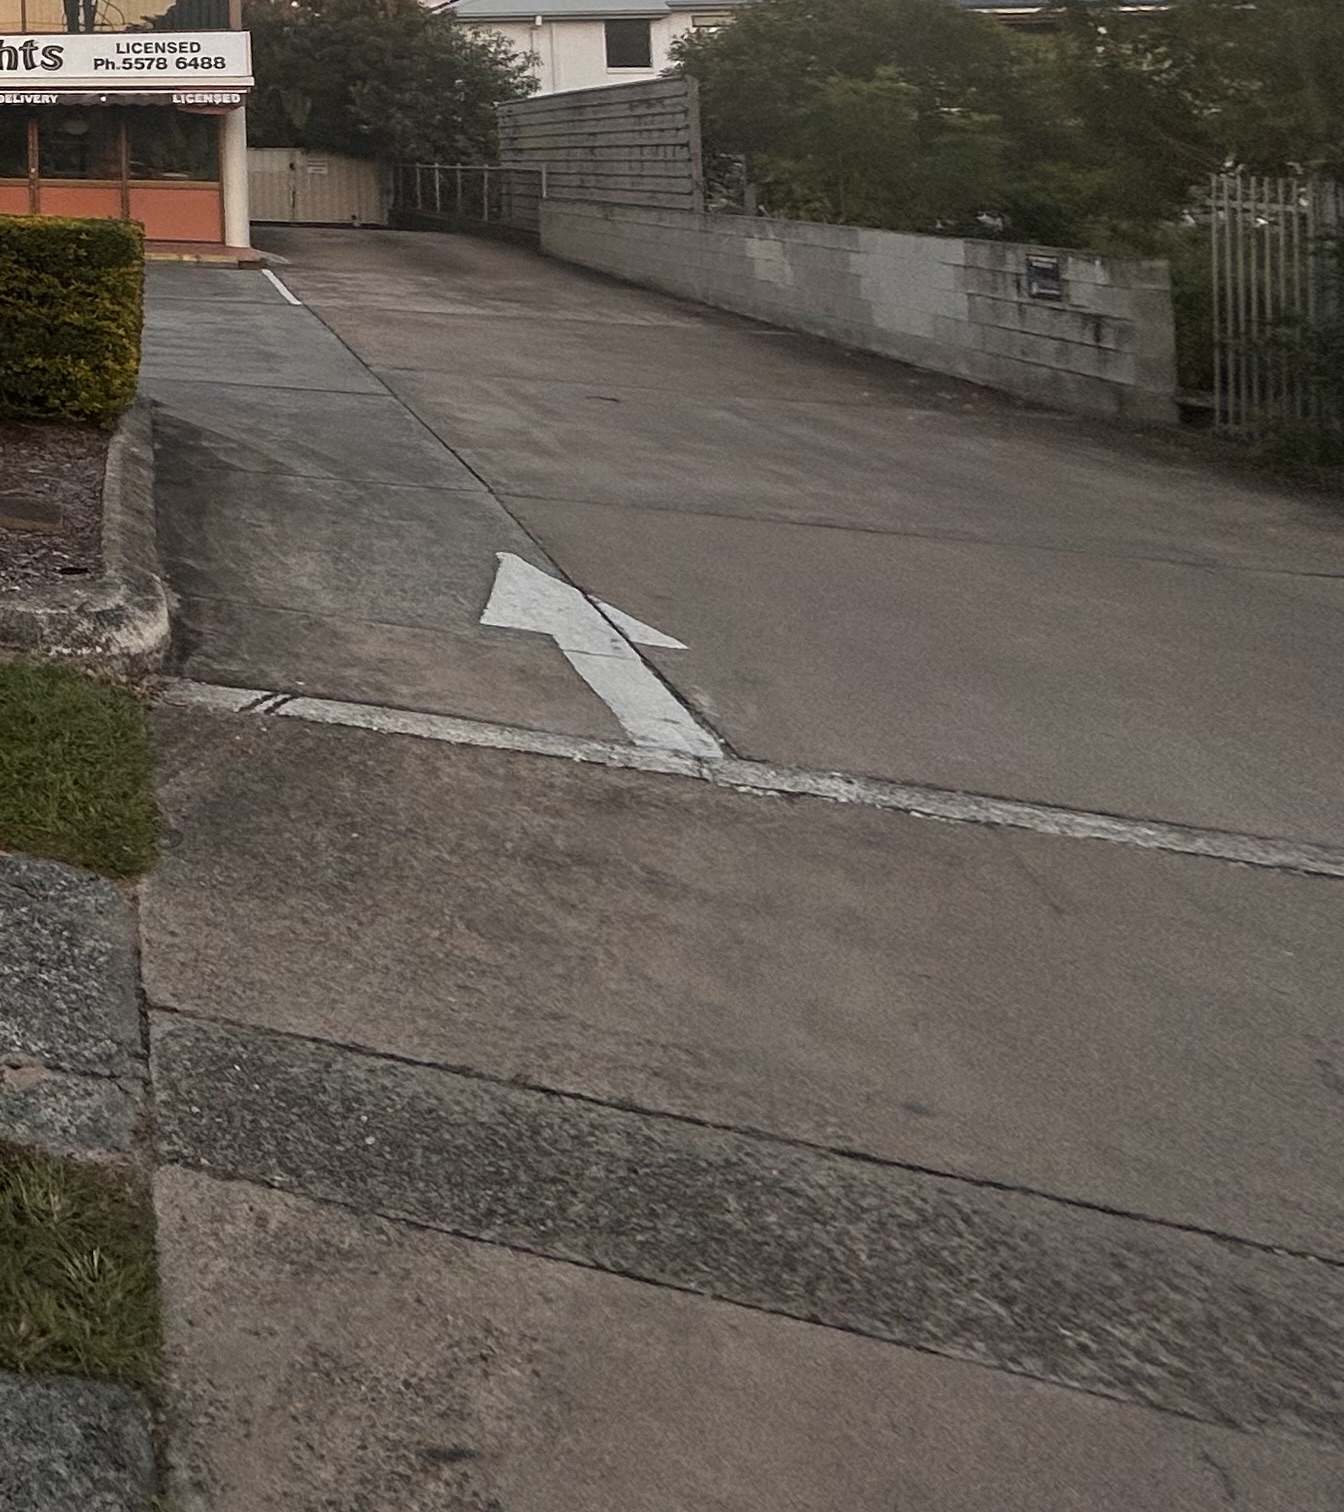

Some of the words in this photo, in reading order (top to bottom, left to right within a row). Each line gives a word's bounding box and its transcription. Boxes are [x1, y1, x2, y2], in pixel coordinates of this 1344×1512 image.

[116, 42, 201, 54] LICENSED
[175, 57, 226, 70] 6488
[172, 93, 241, 105] LICENSED
